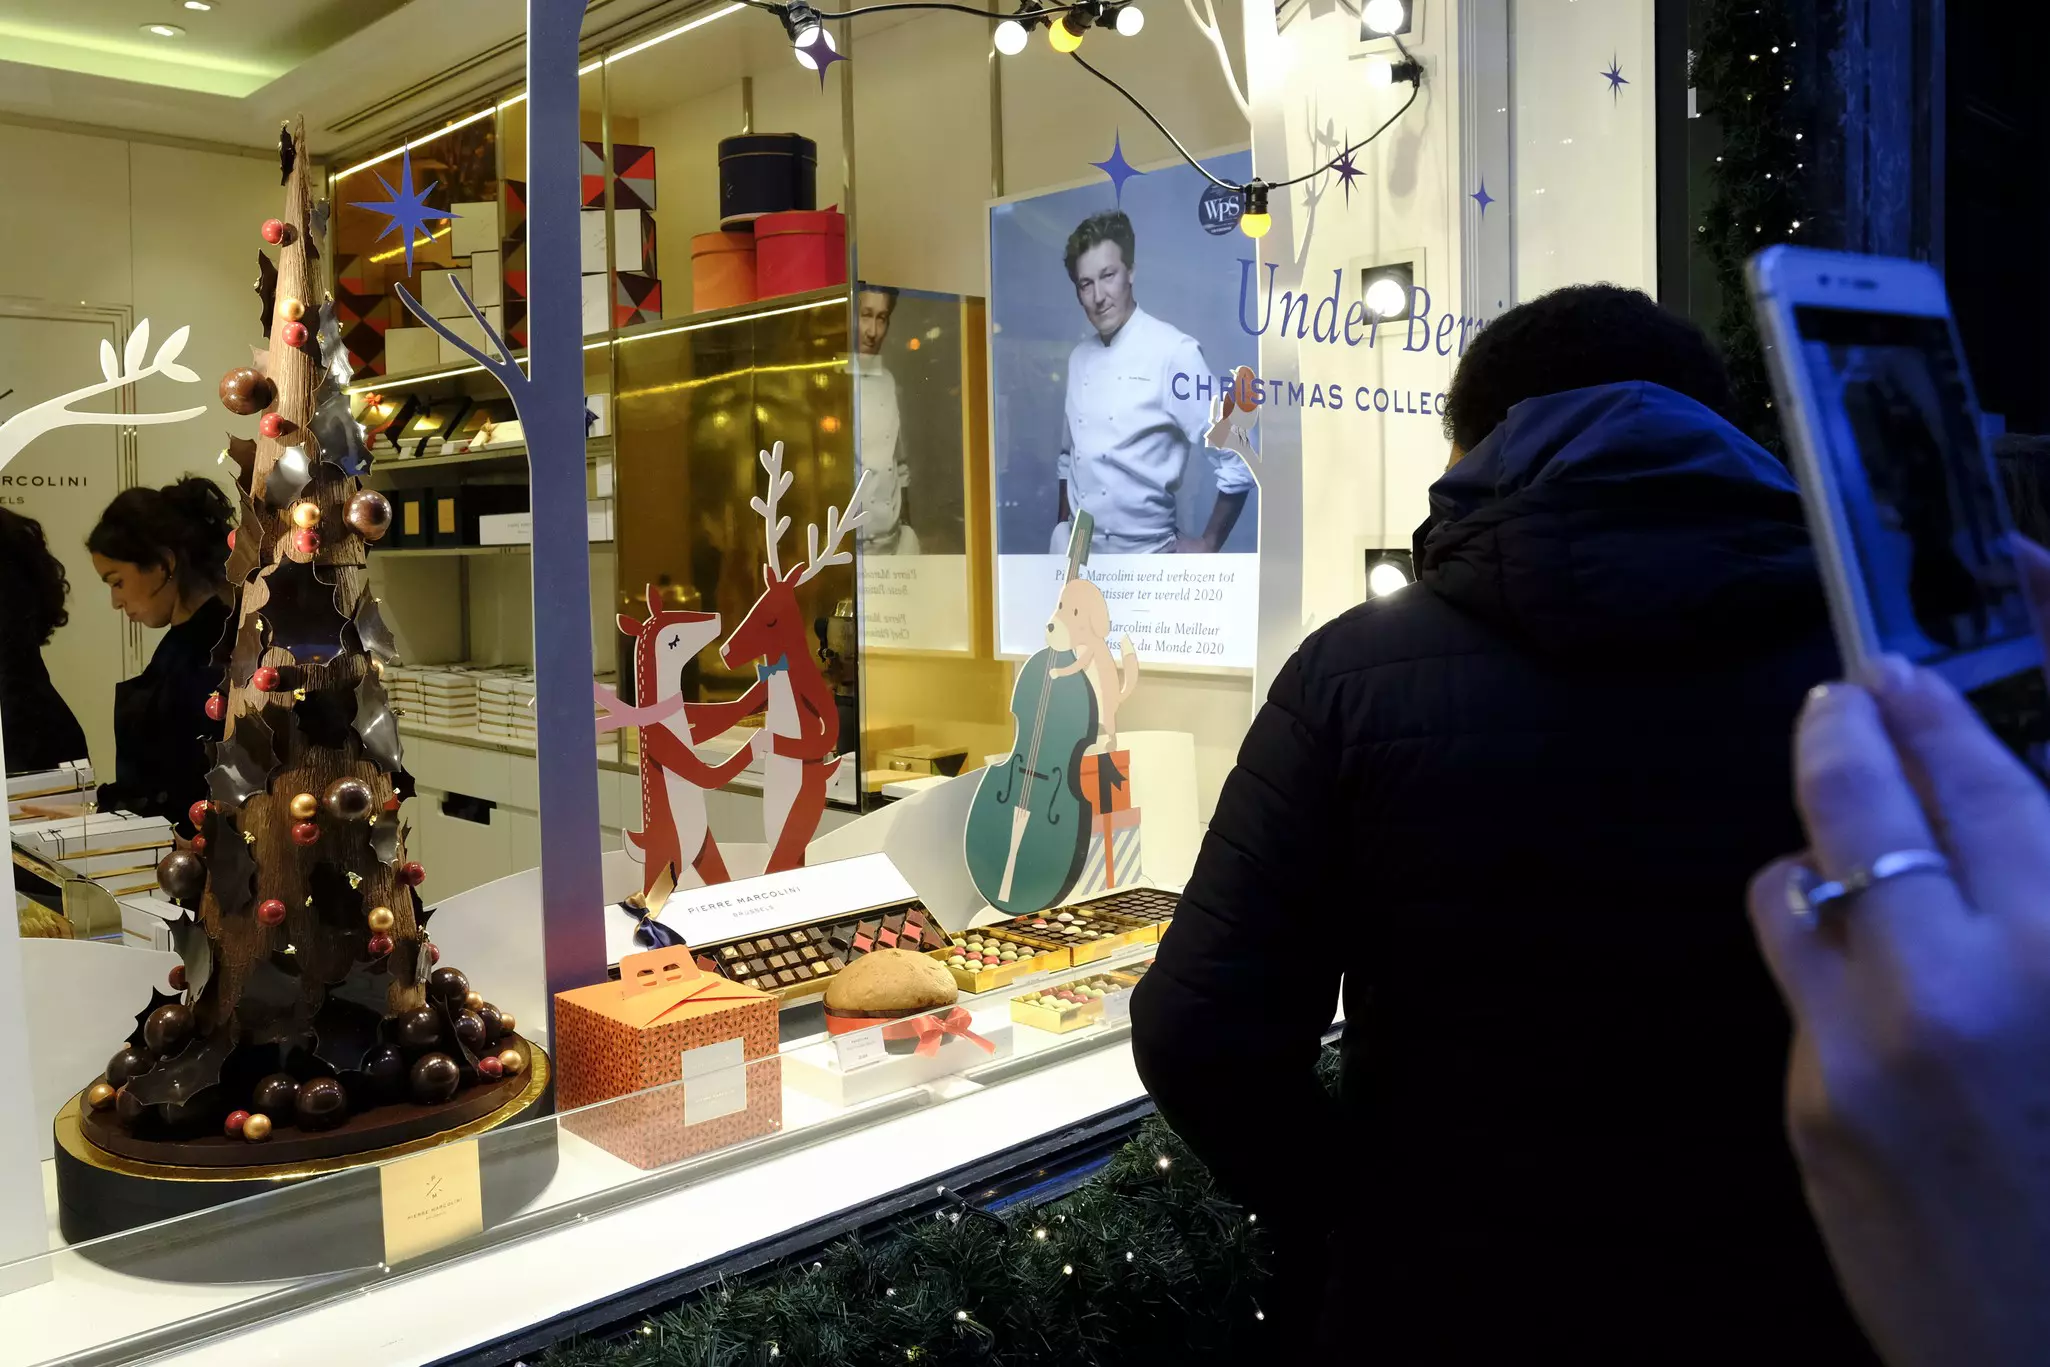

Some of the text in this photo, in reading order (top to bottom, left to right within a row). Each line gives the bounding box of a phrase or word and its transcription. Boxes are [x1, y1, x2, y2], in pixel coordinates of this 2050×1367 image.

[1236, 258, 1386, 349] Under
[1171, 372, 1344, 410] CHRISTMAS
[1086, 569, 1134, 581] Marcolini
[1137, 569, 1164, 582] werd
[1167, 569, 1215, 583] verkozen
[1218, 572, 1235, 583] tot
[1137, 590, 1152, 600] ter
[1154, 587, 1191, 601] wereld
[1194, 588, 1224, 601] 2020
[1154, 621, 1171, 634] élu
[1174, 622, 1220, 636] Meilleur
[1137, 638, 1151, 651] du
[1155, 640, 1193, 653] Monde
[1196, 641, 1225, 655] 2020
[688, 886, 801, 914] PIERRE MARCOLINI
